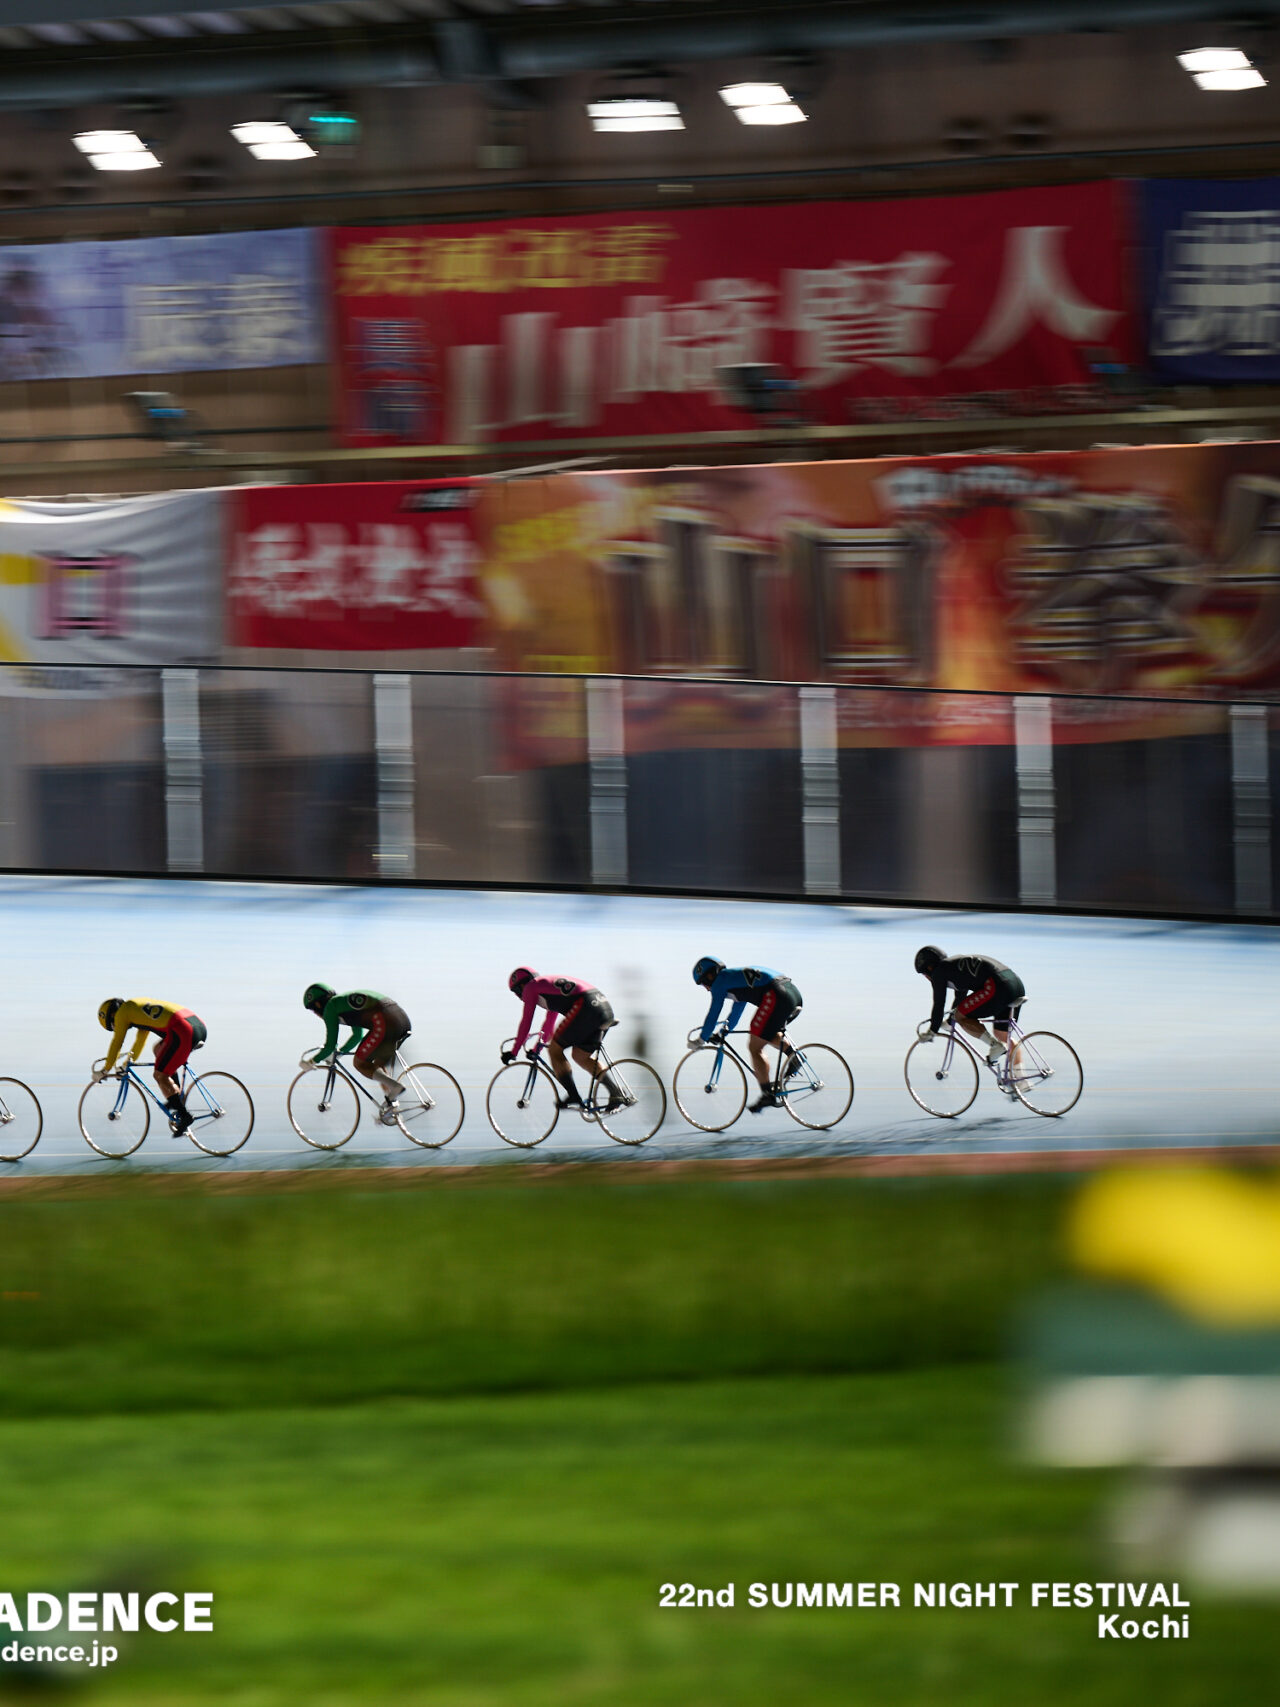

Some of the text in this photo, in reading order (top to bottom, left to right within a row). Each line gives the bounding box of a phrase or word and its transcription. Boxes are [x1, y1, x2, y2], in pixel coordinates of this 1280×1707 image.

[554, 978, 576, 997] 8
[742, 967, 763, 989] 4
[347, 992, 368, 1011] 6
[141, 1003, 165, 1020] 5
